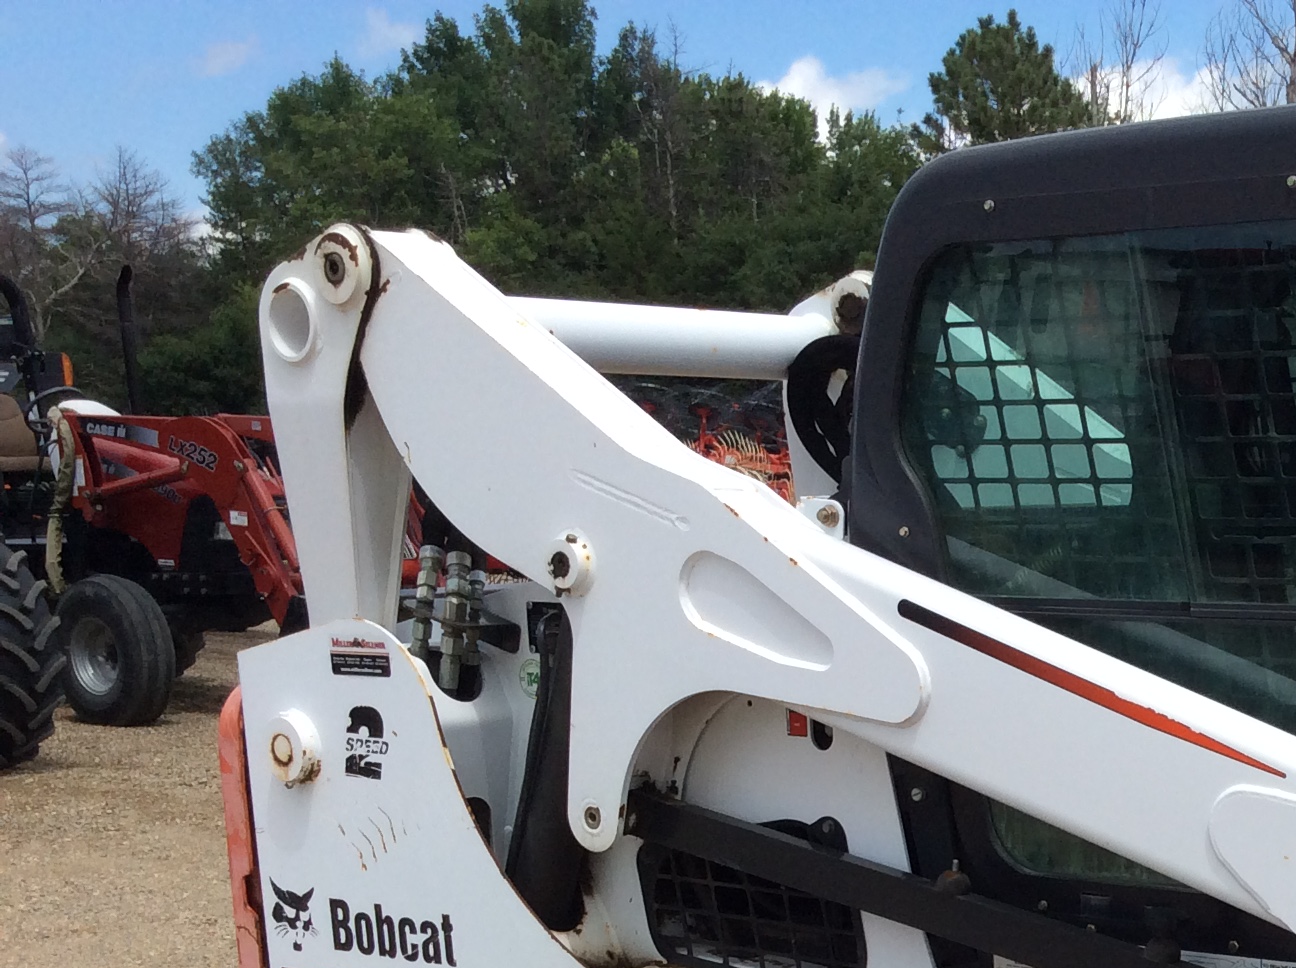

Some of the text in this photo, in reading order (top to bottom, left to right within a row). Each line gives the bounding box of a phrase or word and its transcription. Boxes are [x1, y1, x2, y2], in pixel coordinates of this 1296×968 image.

[86, 422, 115, 436] CASE
[168, 435, 219, 472] LX252
[345, 737, 389, 755] SPEED
[329, 897, 457, 967] Bobcat
